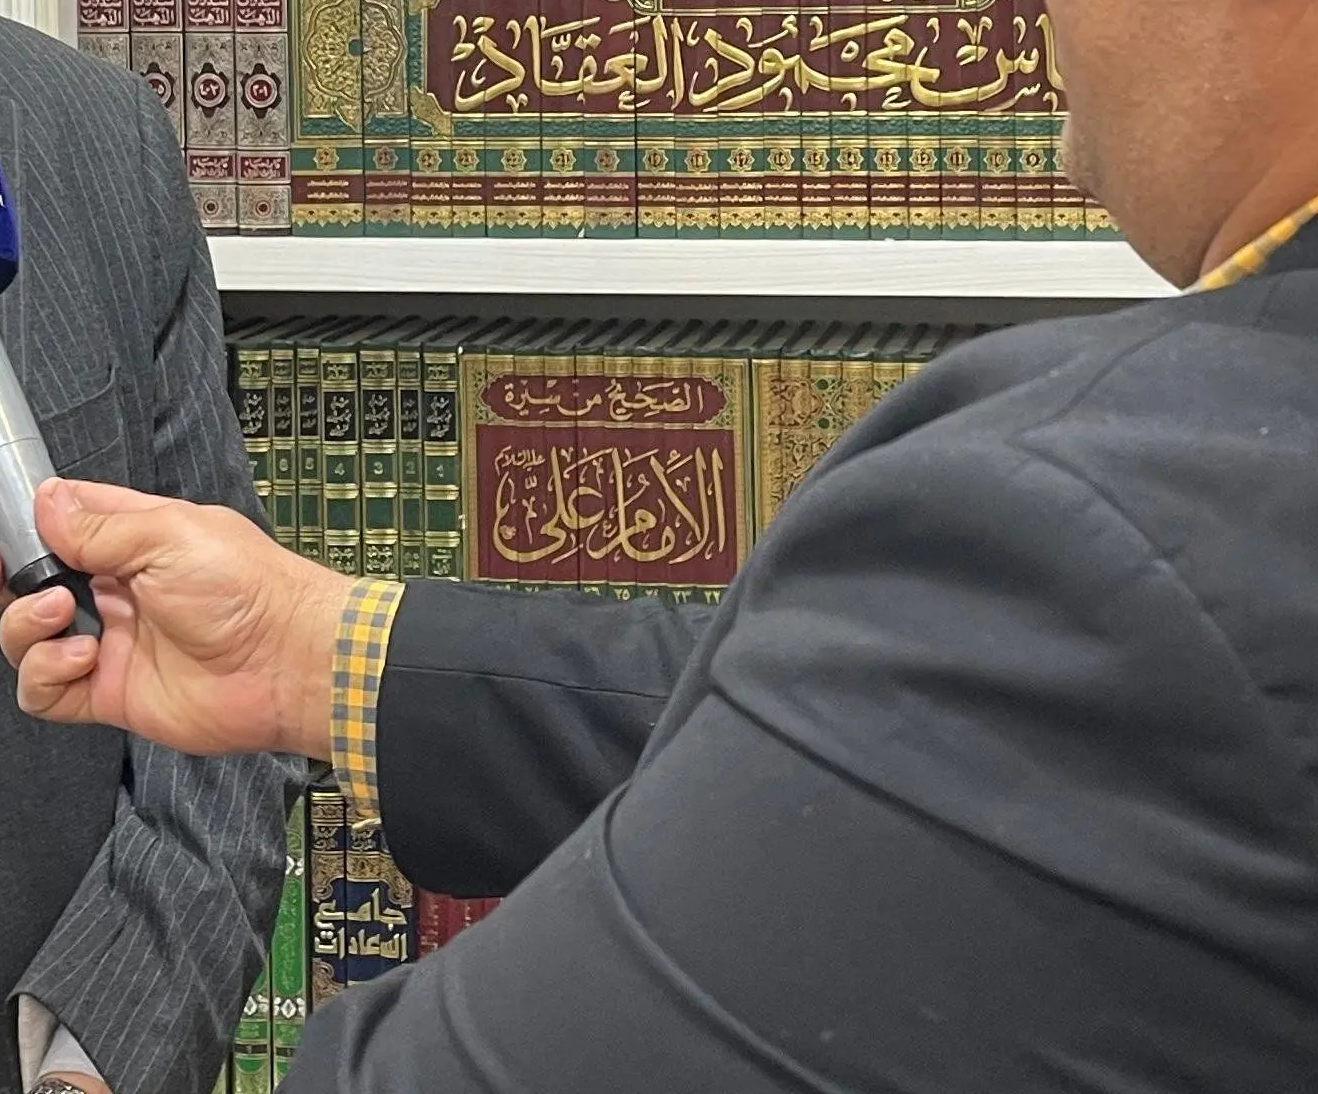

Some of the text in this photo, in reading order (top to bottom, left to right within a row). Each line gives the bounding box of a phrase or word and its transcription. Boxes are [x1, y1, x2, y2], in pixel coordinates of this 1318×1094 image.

[453, 15, 685, 111] العقاد
[690, 19, 914, 112] محمود
[505, 379, 704, 420] الصحيح من سيرة
[494, 447, 605, 564] علي
[313, 888, 407, 931] جامع
[314, 927, 408, 963] السعادات
